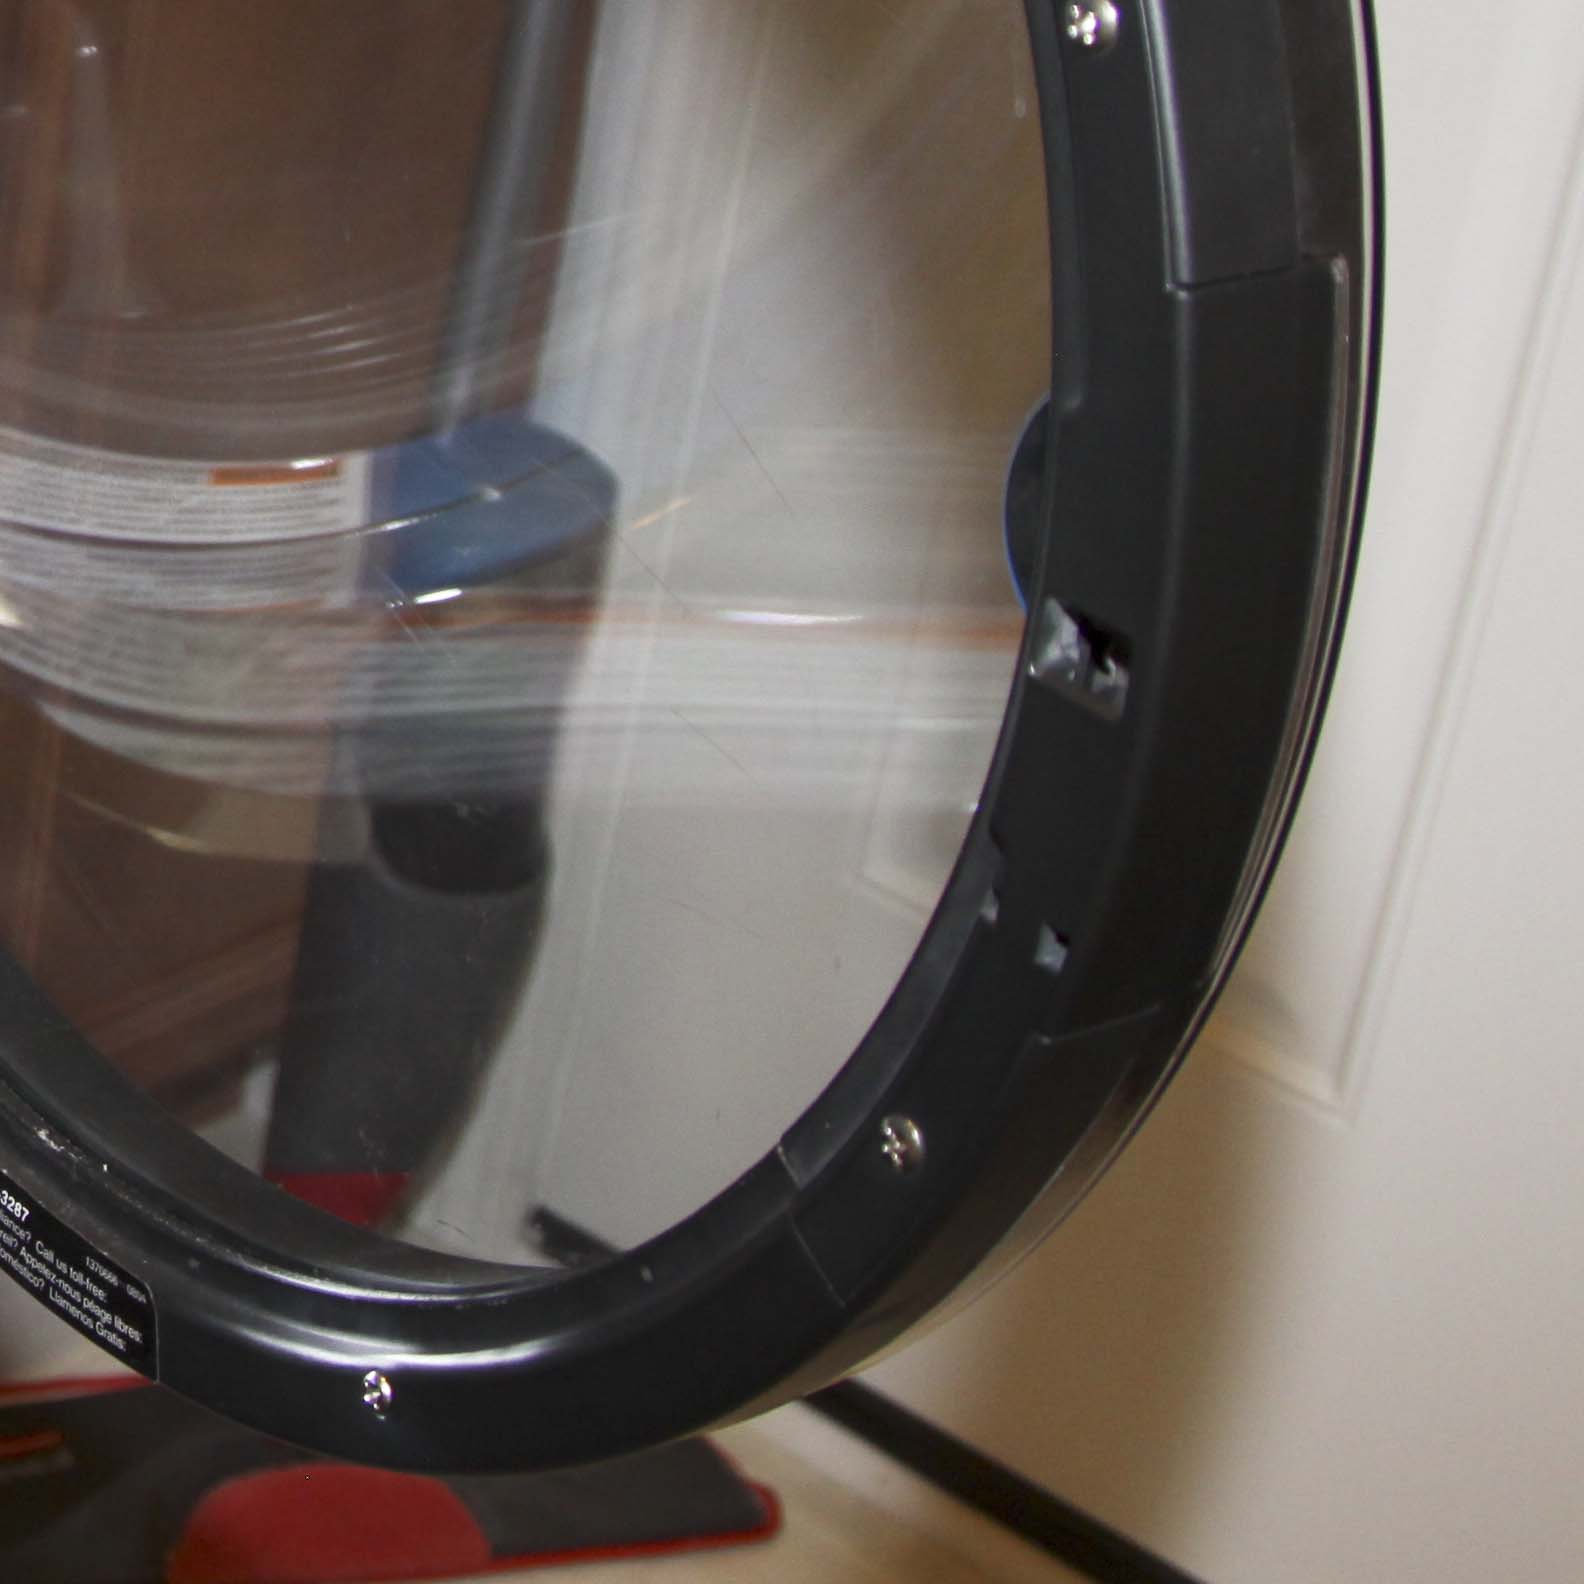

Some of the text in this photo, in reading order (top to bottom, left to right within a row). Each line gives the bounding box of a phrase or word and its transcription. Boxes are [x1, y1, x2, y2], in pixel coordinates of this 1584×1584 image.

[19, 1245, 82, 1303] Appelez-nous
[35, 1239, 55, 1264] Call
[55, 1258, 69, 1275] us
